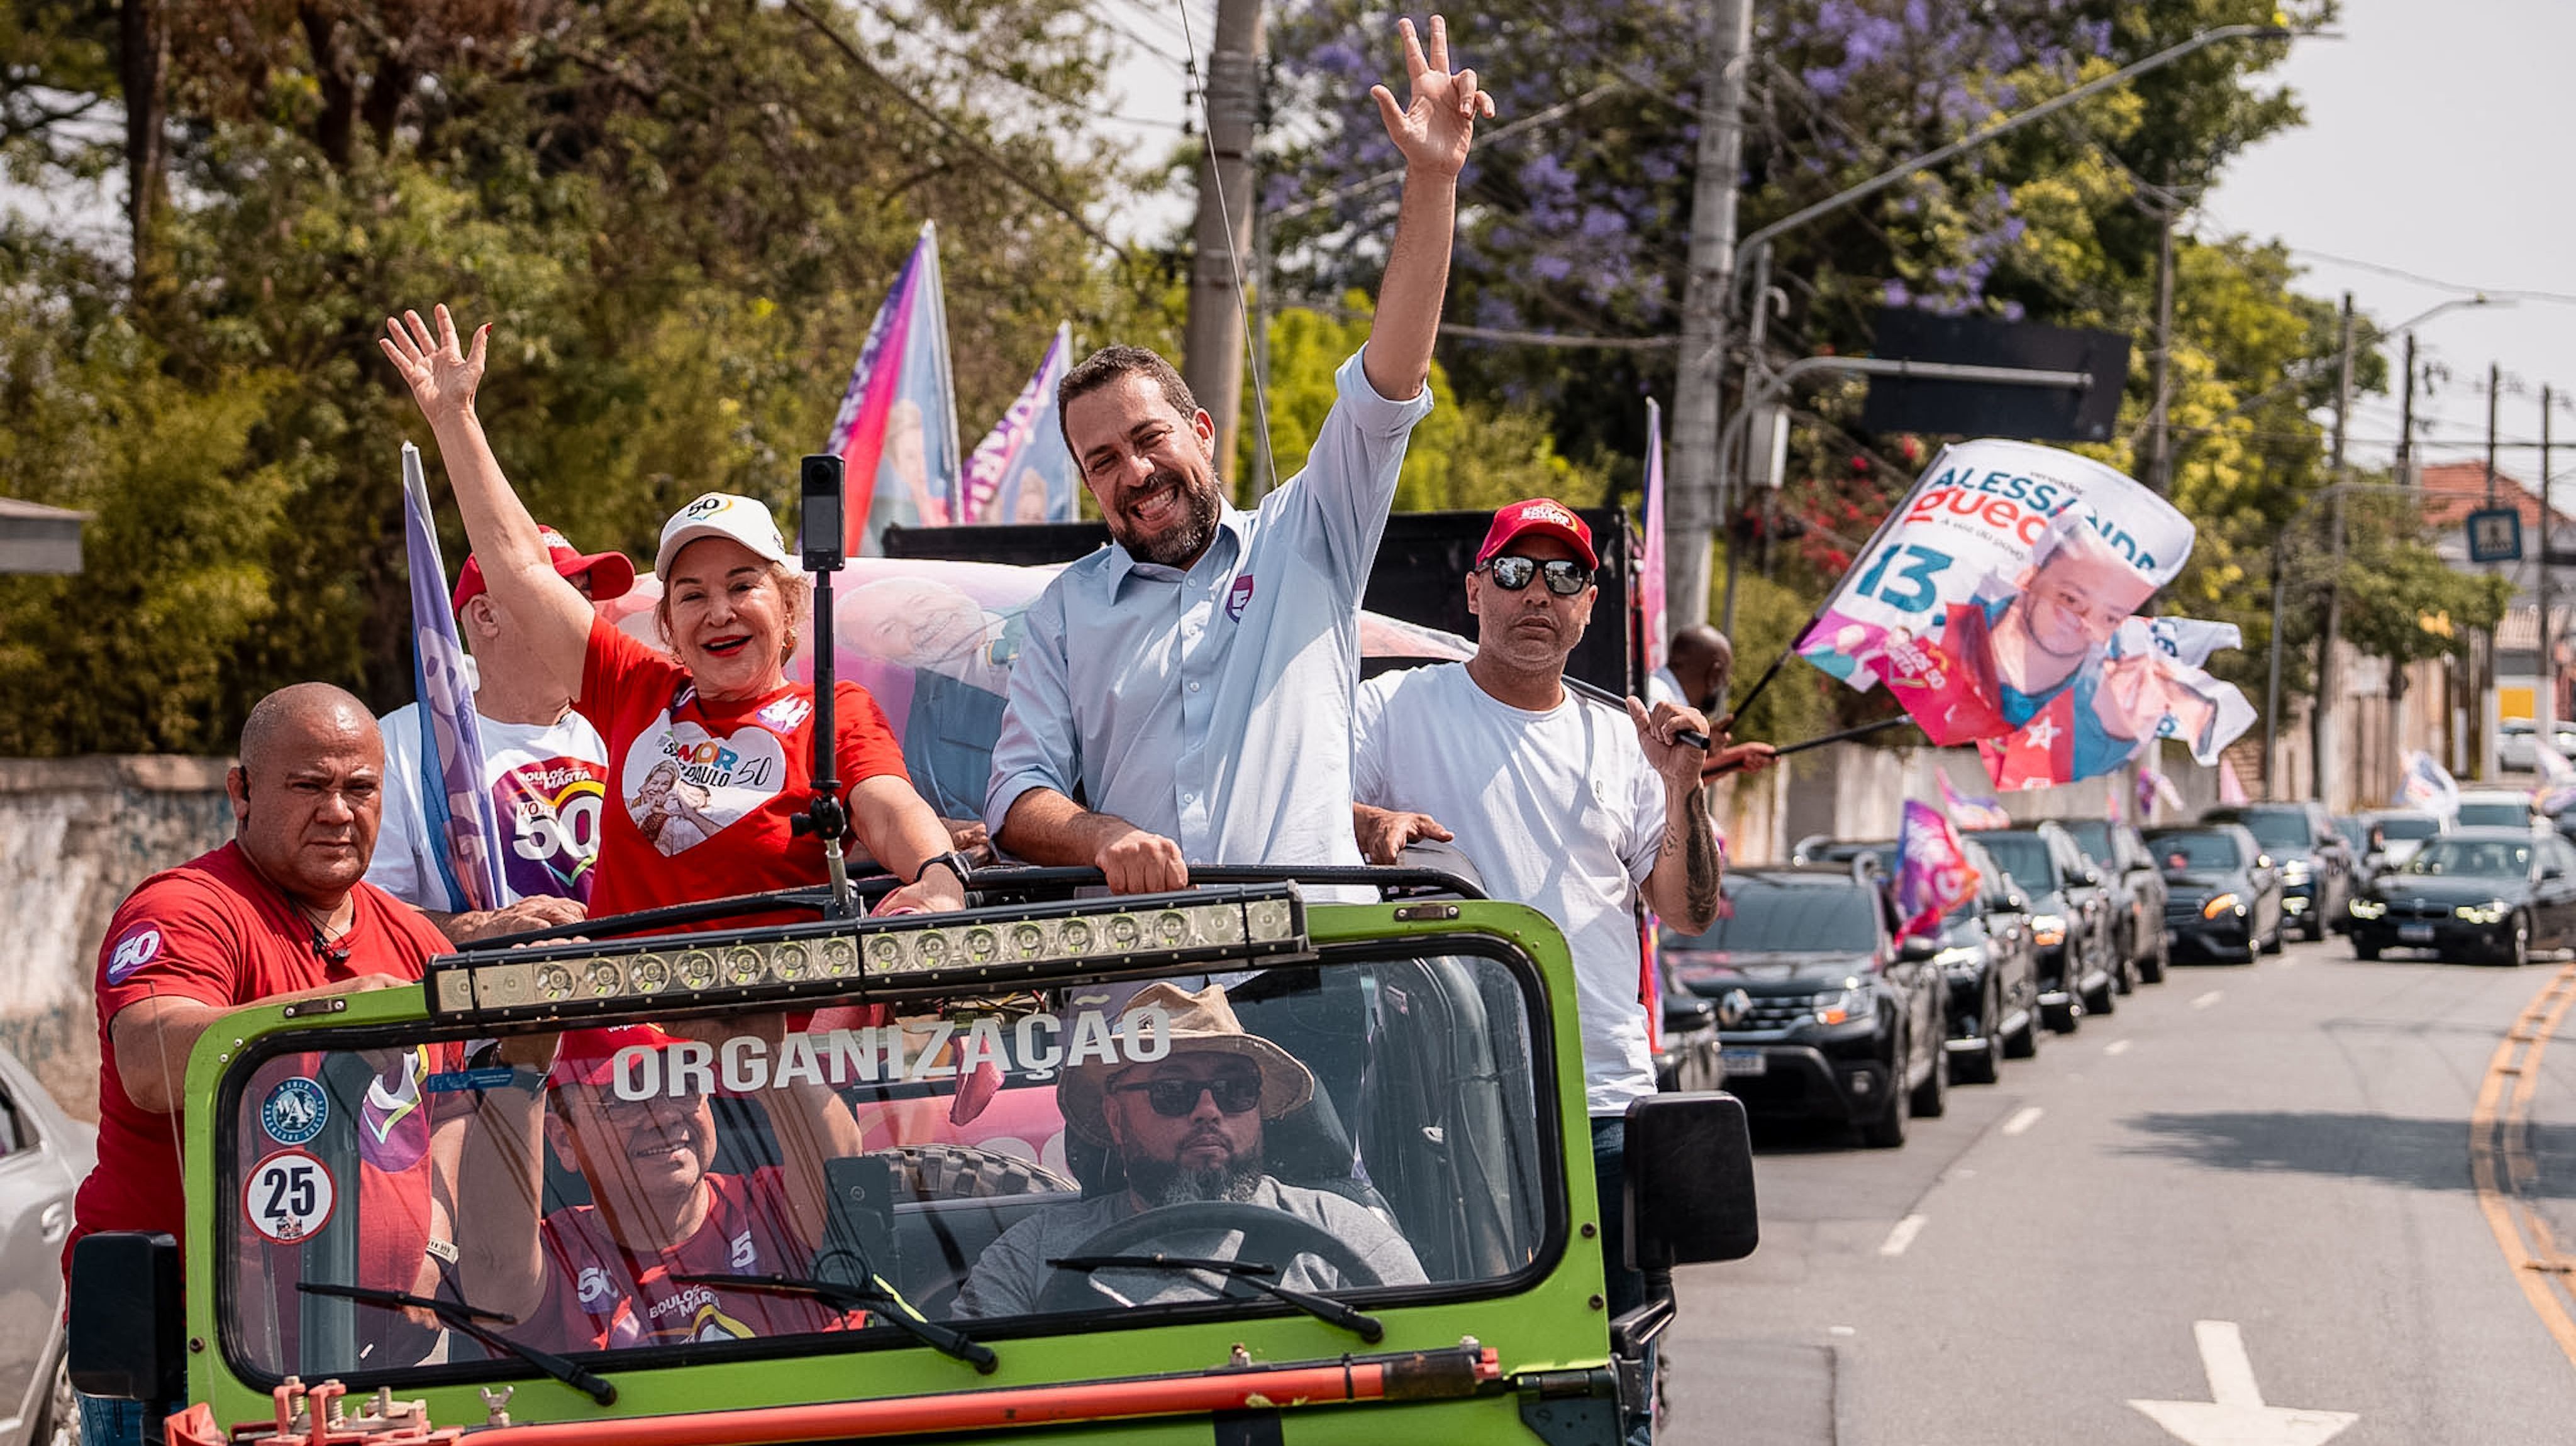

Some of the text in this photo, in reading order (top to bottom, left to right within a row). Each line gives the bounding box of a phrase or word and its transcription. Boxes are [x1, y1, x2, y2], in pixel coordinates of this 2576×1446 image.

[687, 499, 719, 517] 50
[543, 770, 592, 790] MARTA
[684, 766, 731, 786] PAULO
[734, 757, 772, 785] 50
[513, 796, 604, 861] 50
[109, 930, 160, 974] 50
[613, 994, 1172, 1101] ORGANIZAÇÃO
[276, 1095, 314, 1124] WAS
[264, 1166, 315, 1218] 25
[649, 1284, 700, 1319] BOULOS
